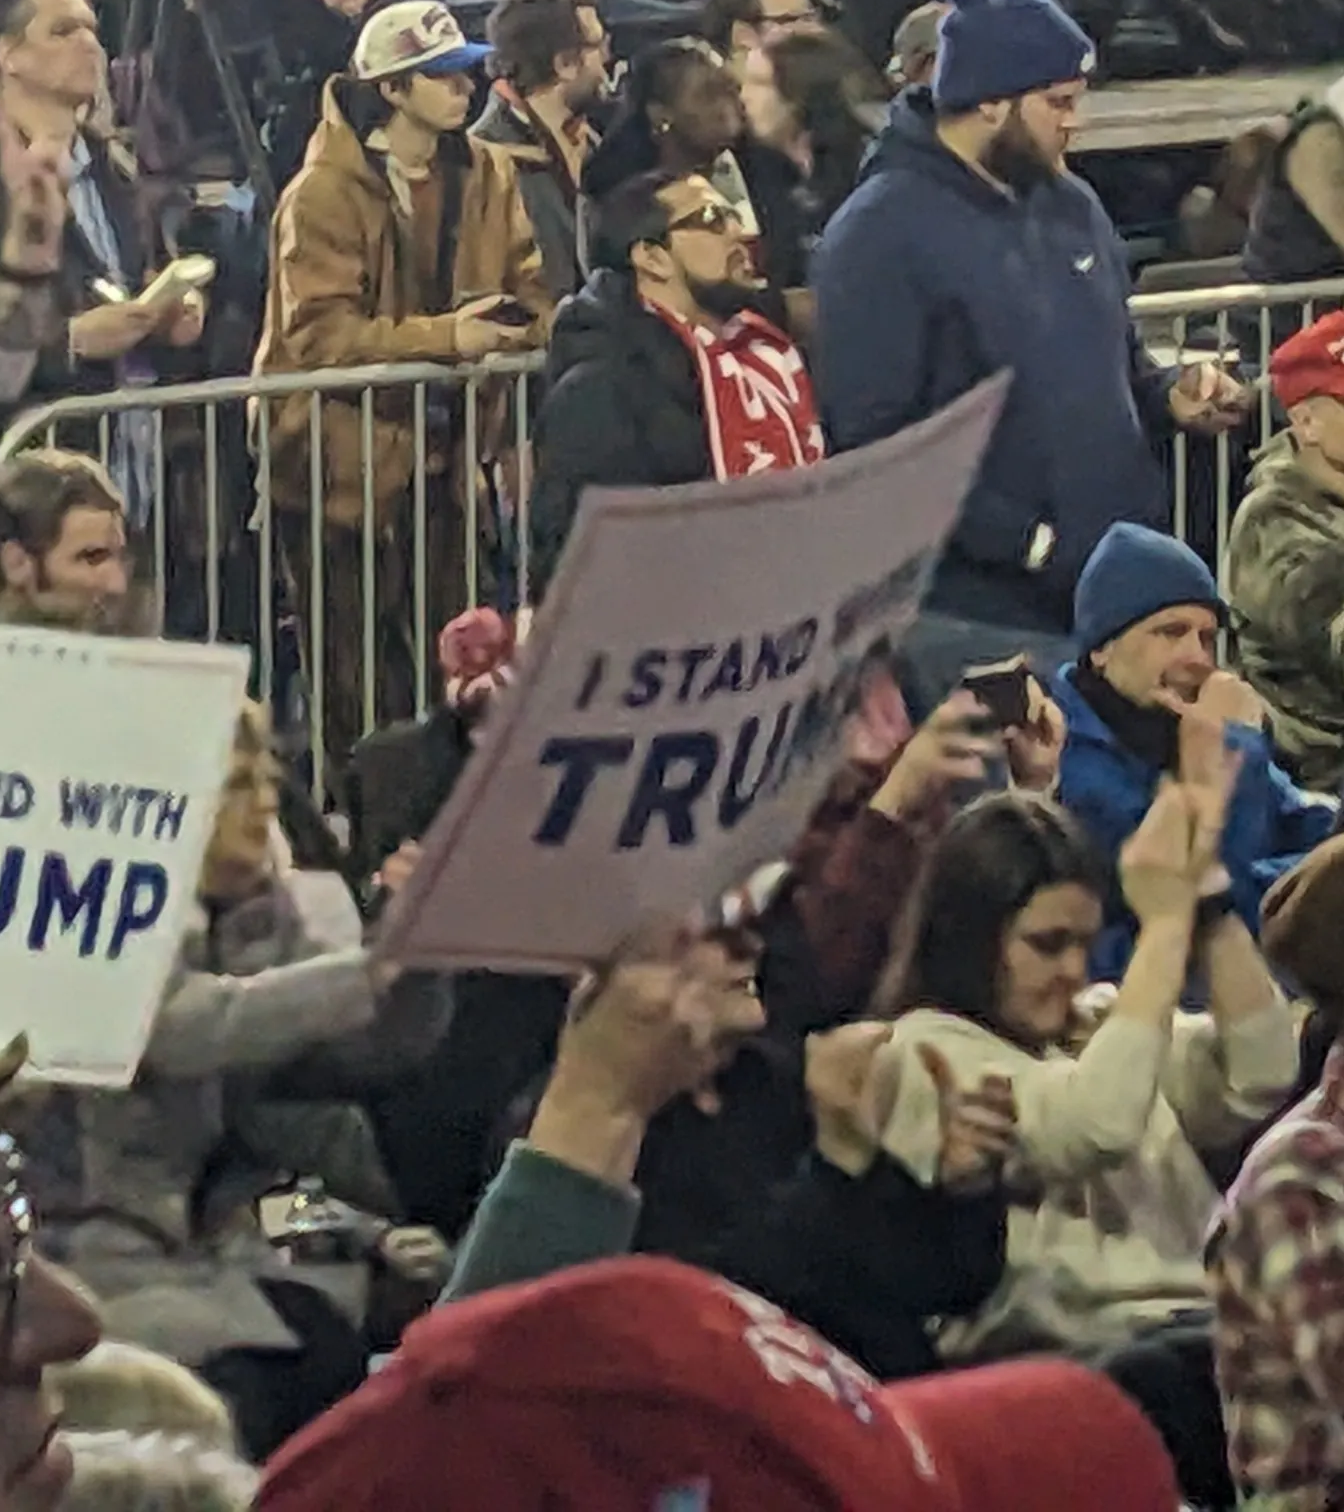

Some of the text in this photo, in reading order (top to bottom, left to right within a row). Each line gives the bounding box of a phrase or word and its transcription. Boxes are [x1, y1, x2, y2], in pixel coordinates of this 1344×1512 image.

[574, 616, 819, 710] I STAND
[59, 775, 189, 842] WITH
